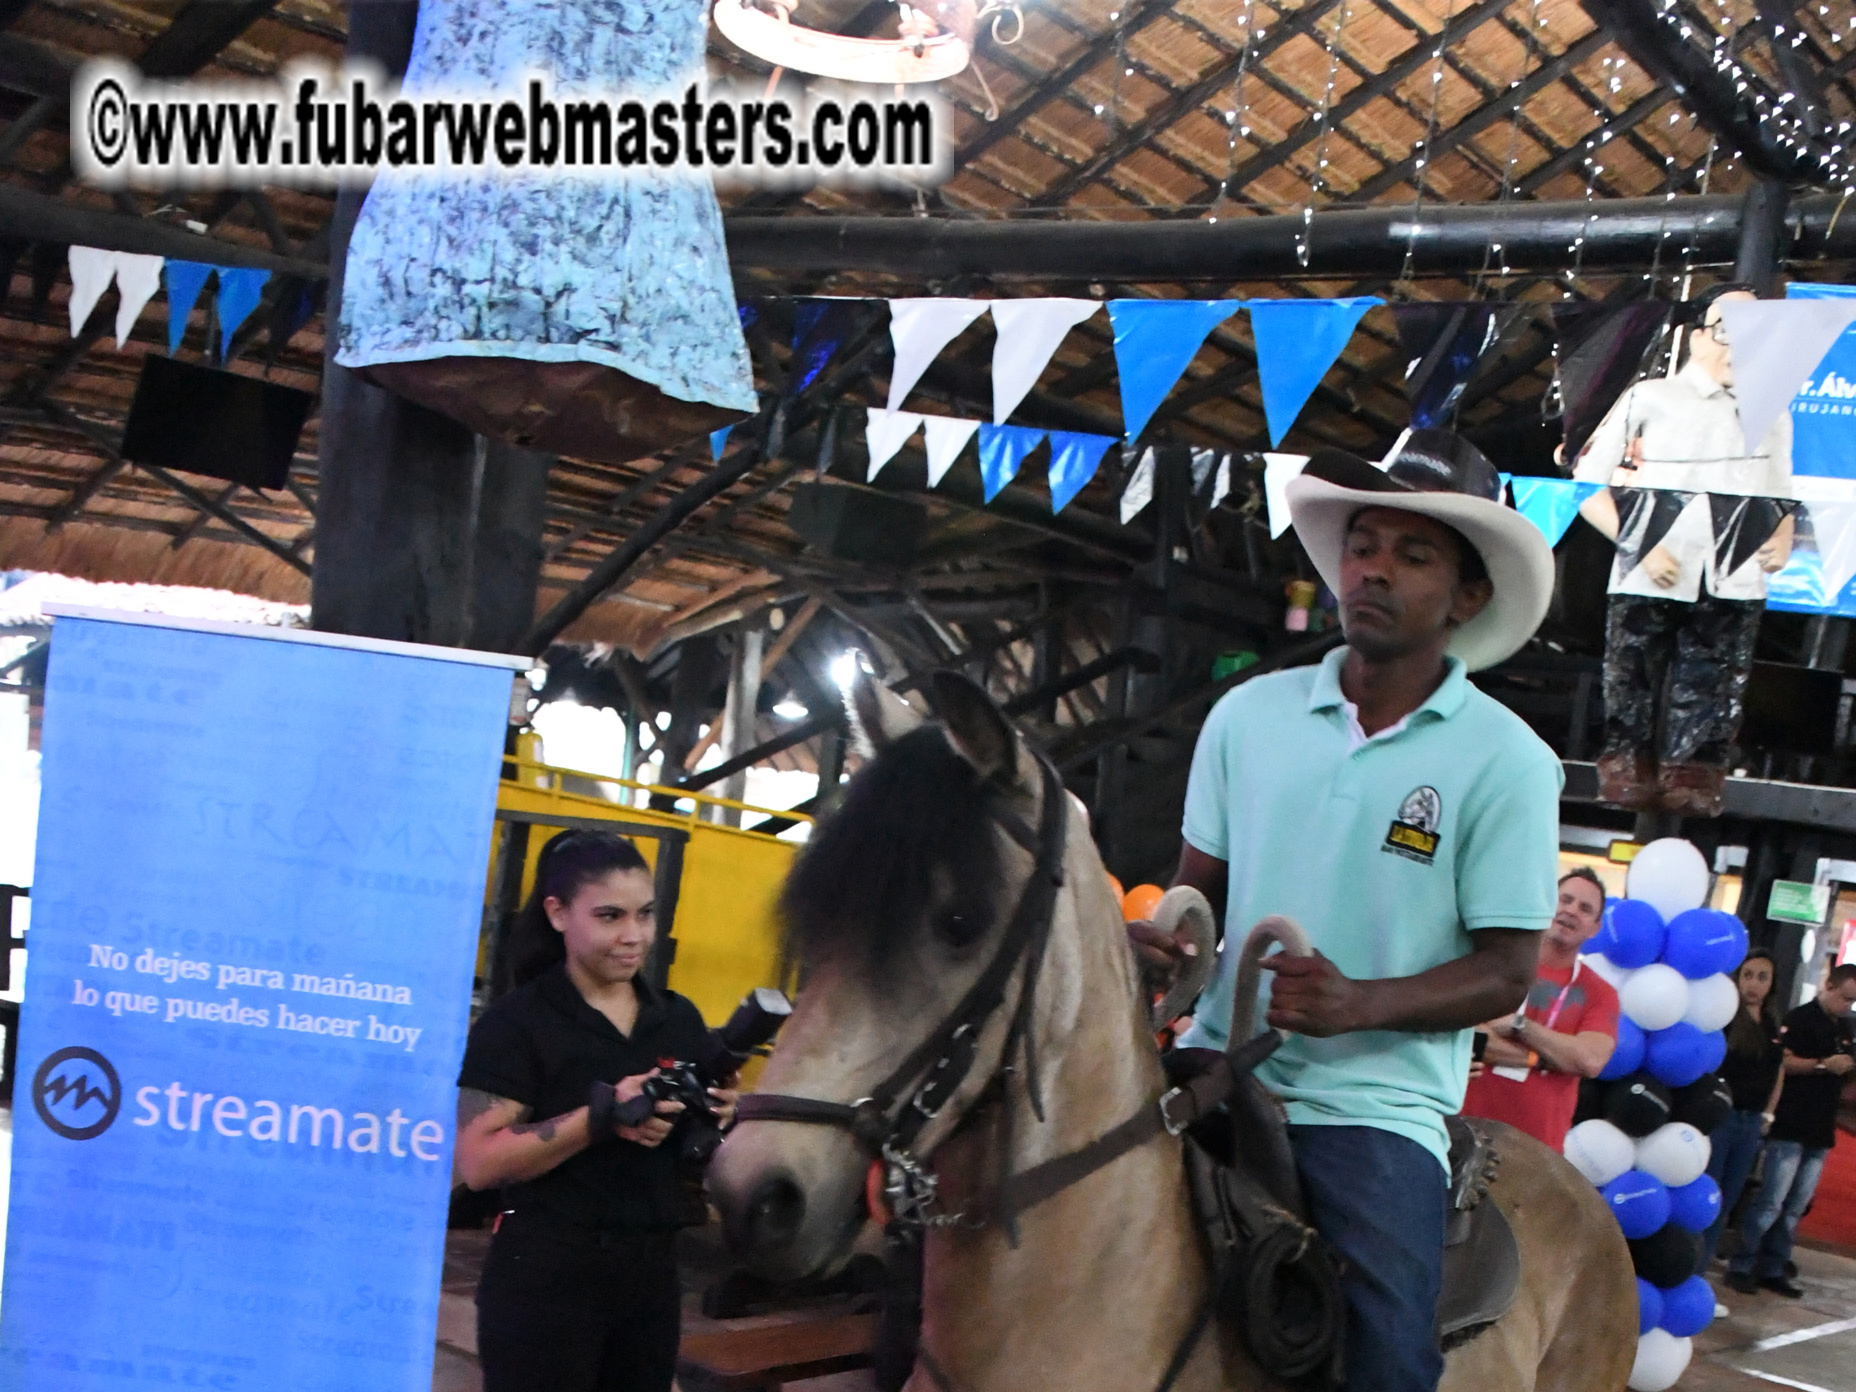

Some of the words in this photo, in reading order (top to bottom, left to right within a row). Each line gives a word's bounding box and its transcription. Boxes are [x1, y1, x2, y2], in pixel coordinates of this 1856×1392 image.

[88, 943, 129, 971] No
[135, 948, 212, 984] dejes
[216, 963, 285, 990] para
[291, 973, 413, 1005] mañana
[71, 979, 99, 1007] lo
[104, 989, 159, 1017] que
[164, 998, 270, 1028] puedes
[276, 1004, 361, 1038] hacer
[366, 1015, 422, 1052] hoy
[133, 1081, 444, 1162] streamate
